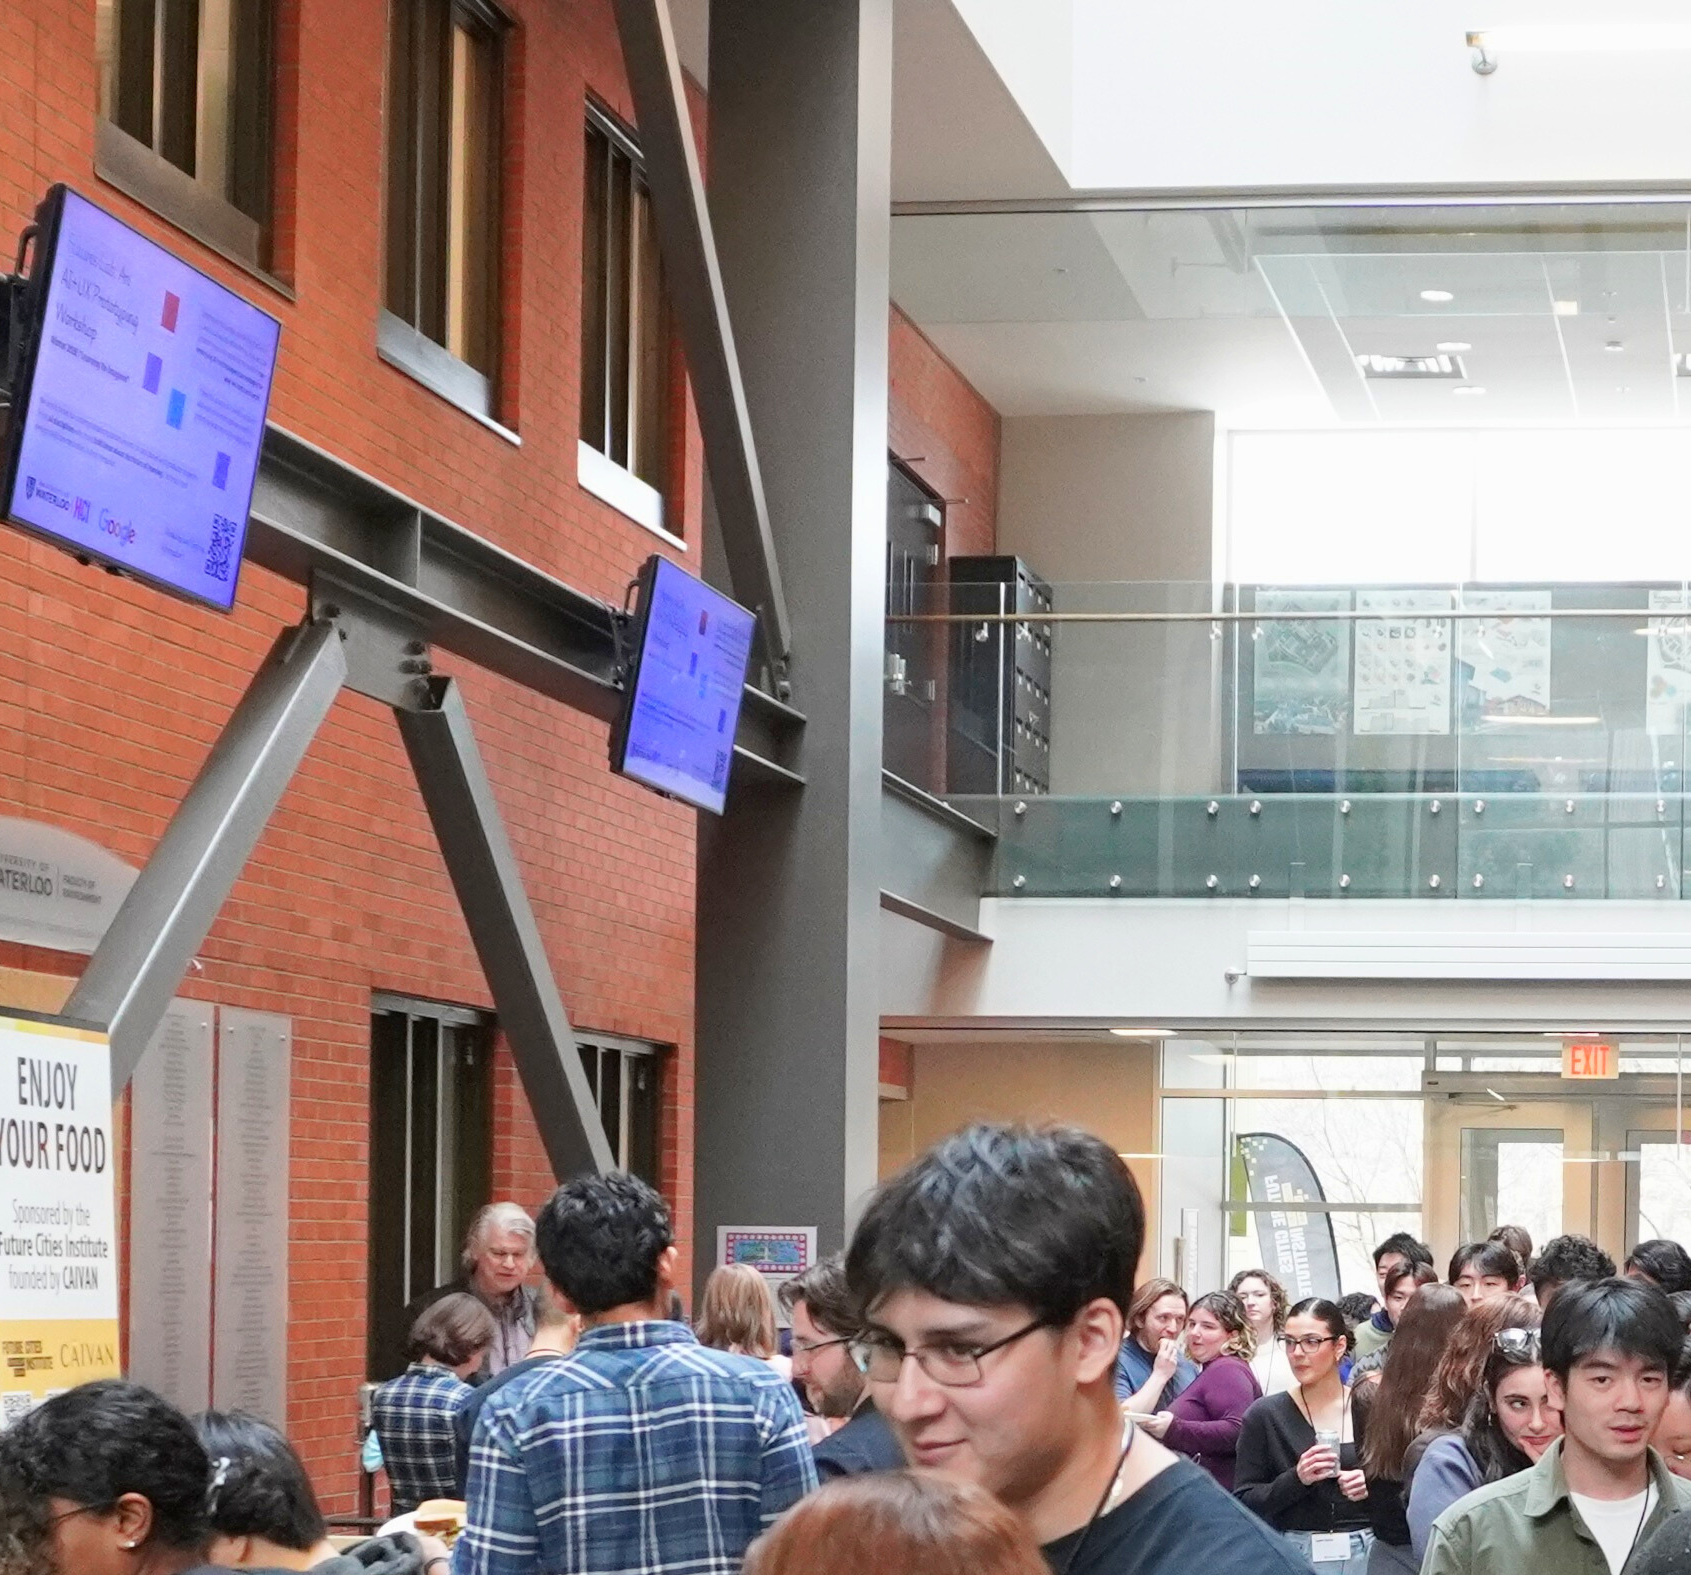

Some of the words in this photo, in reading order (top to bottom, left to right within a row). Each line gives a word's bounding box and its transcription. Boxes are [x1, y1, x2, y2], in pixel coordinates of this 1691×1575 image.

[99, 507, 136, 547] Google
[39, 862, 49, 872] OF
[1571, 1045, 1610, 1075] EXIT
[17, 1056, 77, 1111] ENJOY
[56, 1123, 106, 1174] FOOD
[13, 1198, 60, 1230] Sponsored
[63, 1201, 74, 1233] by
[76, 1202, 91, 1227] the
[35, 1232, 63, 1258] Cities
[65, 1233, 109, 1258] Institute
[9, 1264, 47, 1290] founded
[50, 1265, 60, 1296] by
[62, 1266, 98, 1290] CAIVAN
[60, 1342, 115, 1368] CAIVAN
